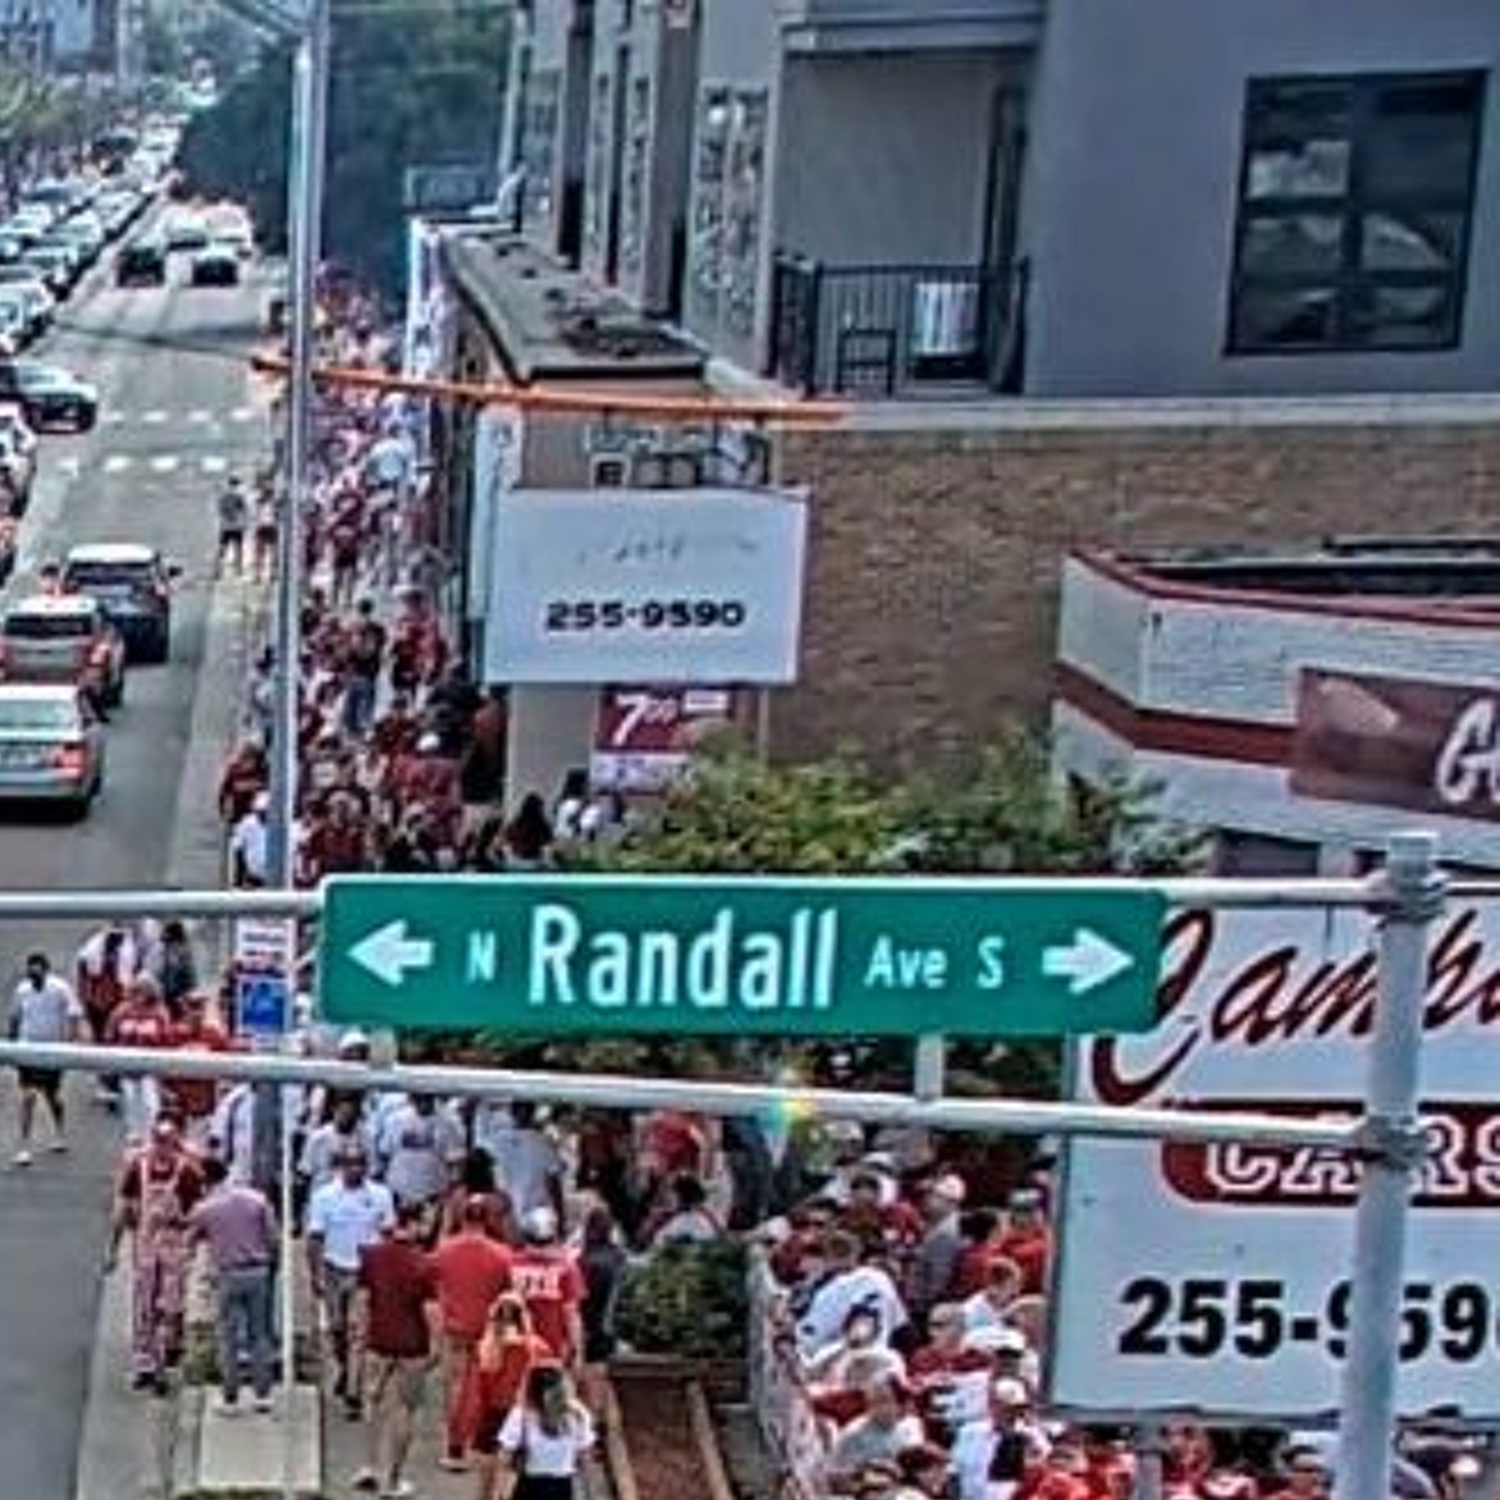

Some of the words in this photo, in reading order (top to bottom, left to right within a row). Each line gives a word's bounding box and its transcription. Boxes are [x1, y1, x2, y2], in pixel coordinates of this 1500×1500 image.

[466, 932, 497, 982] N
[528, 904, 840, 1010] Randall
[864, 936, 948, 990] Ave
[978, 936, 1005, 989] S
[1118, 1275, 1500, 1363] 255-59
